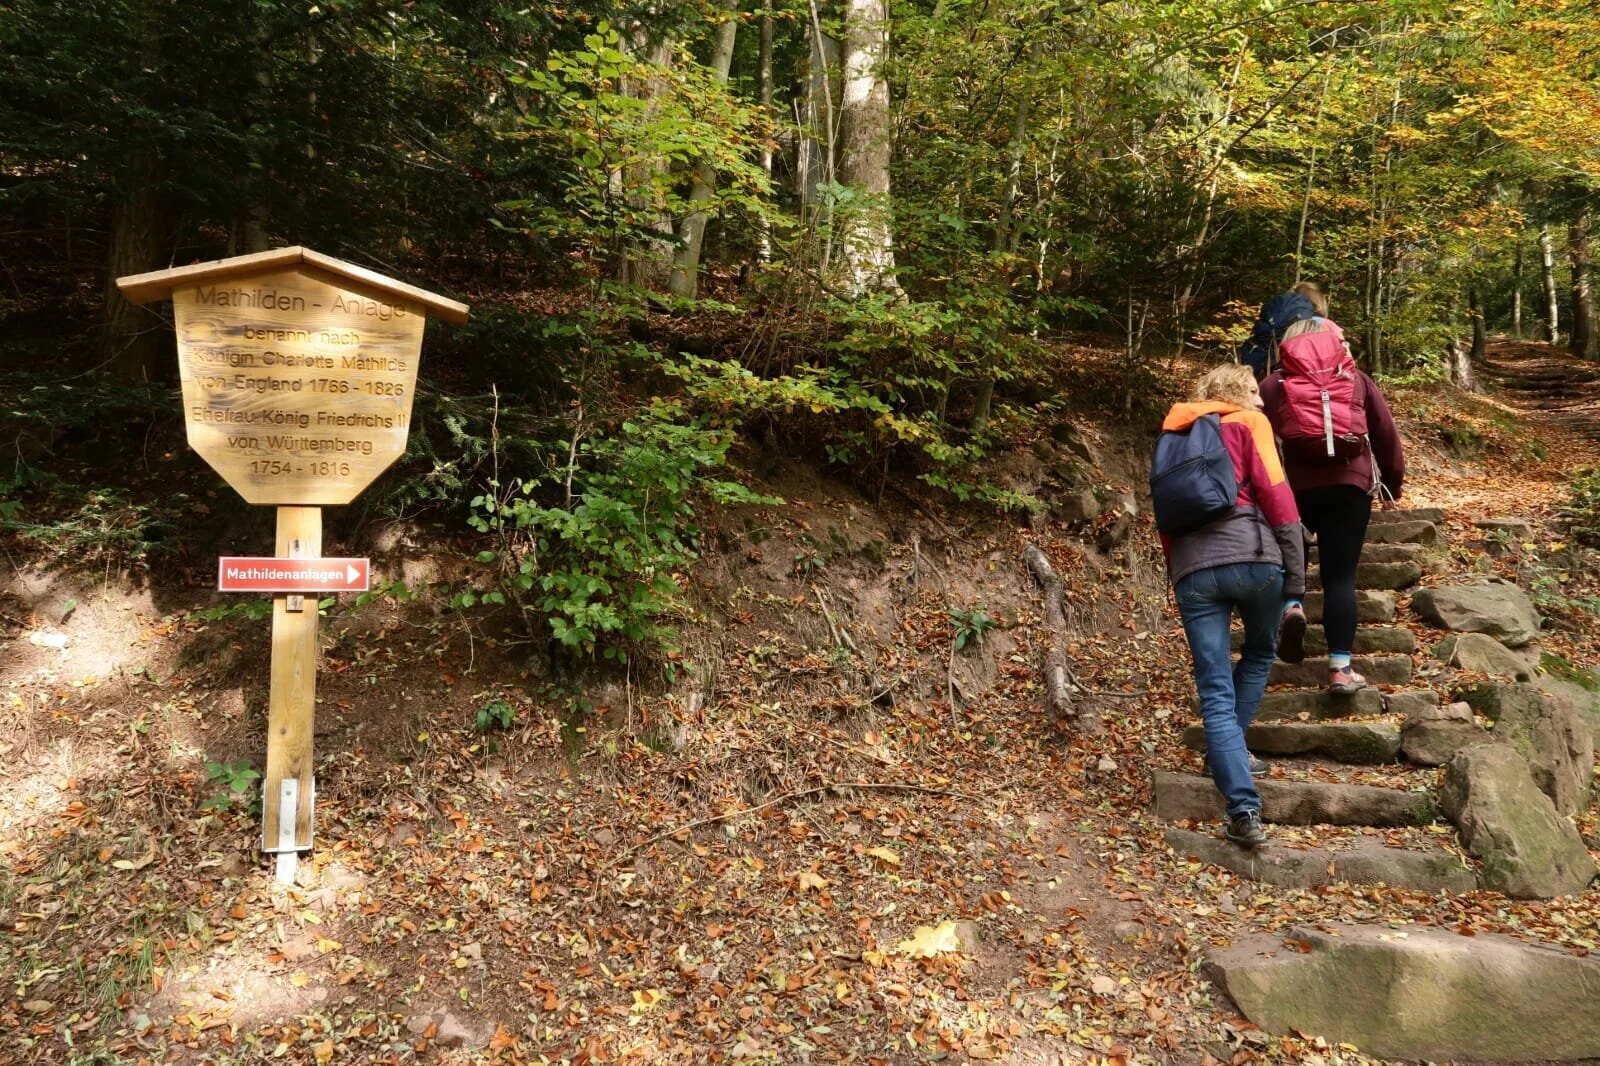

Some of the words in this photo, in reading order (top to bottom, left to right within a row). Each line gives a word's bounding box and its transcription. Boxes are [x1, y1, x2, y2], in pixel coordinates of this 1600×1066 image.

[195, 286, 305, 311] Mathilden
[330, 294, 406, 321] Anlage
[243, 325, 312, 342] benannt
[320, 331, 360, 345] nach
[192, 348, 254, 368] Königin
[262, 351, 335, 368] Charlotte
[341, 355, 407, 372] Mathilde
[195, 375, 226, 389] von
[234, 374, 303, 393] England
[309, 379, 350, 394] 1766
[365, 381, 404, 396] 1826
[191, 406, 256, 423] Ehefrau
[262, 409, 310, 428] König
[317, 411, 393, 428] Friedrichs
[228, 436, 259, 450] von
[266, 434, 374, 456] Württemberg
[251, 460, 293, 476] 1754
[309, 461, 351, 477] 1816
[226, 567, 344, 583] Mathildenanlagen
